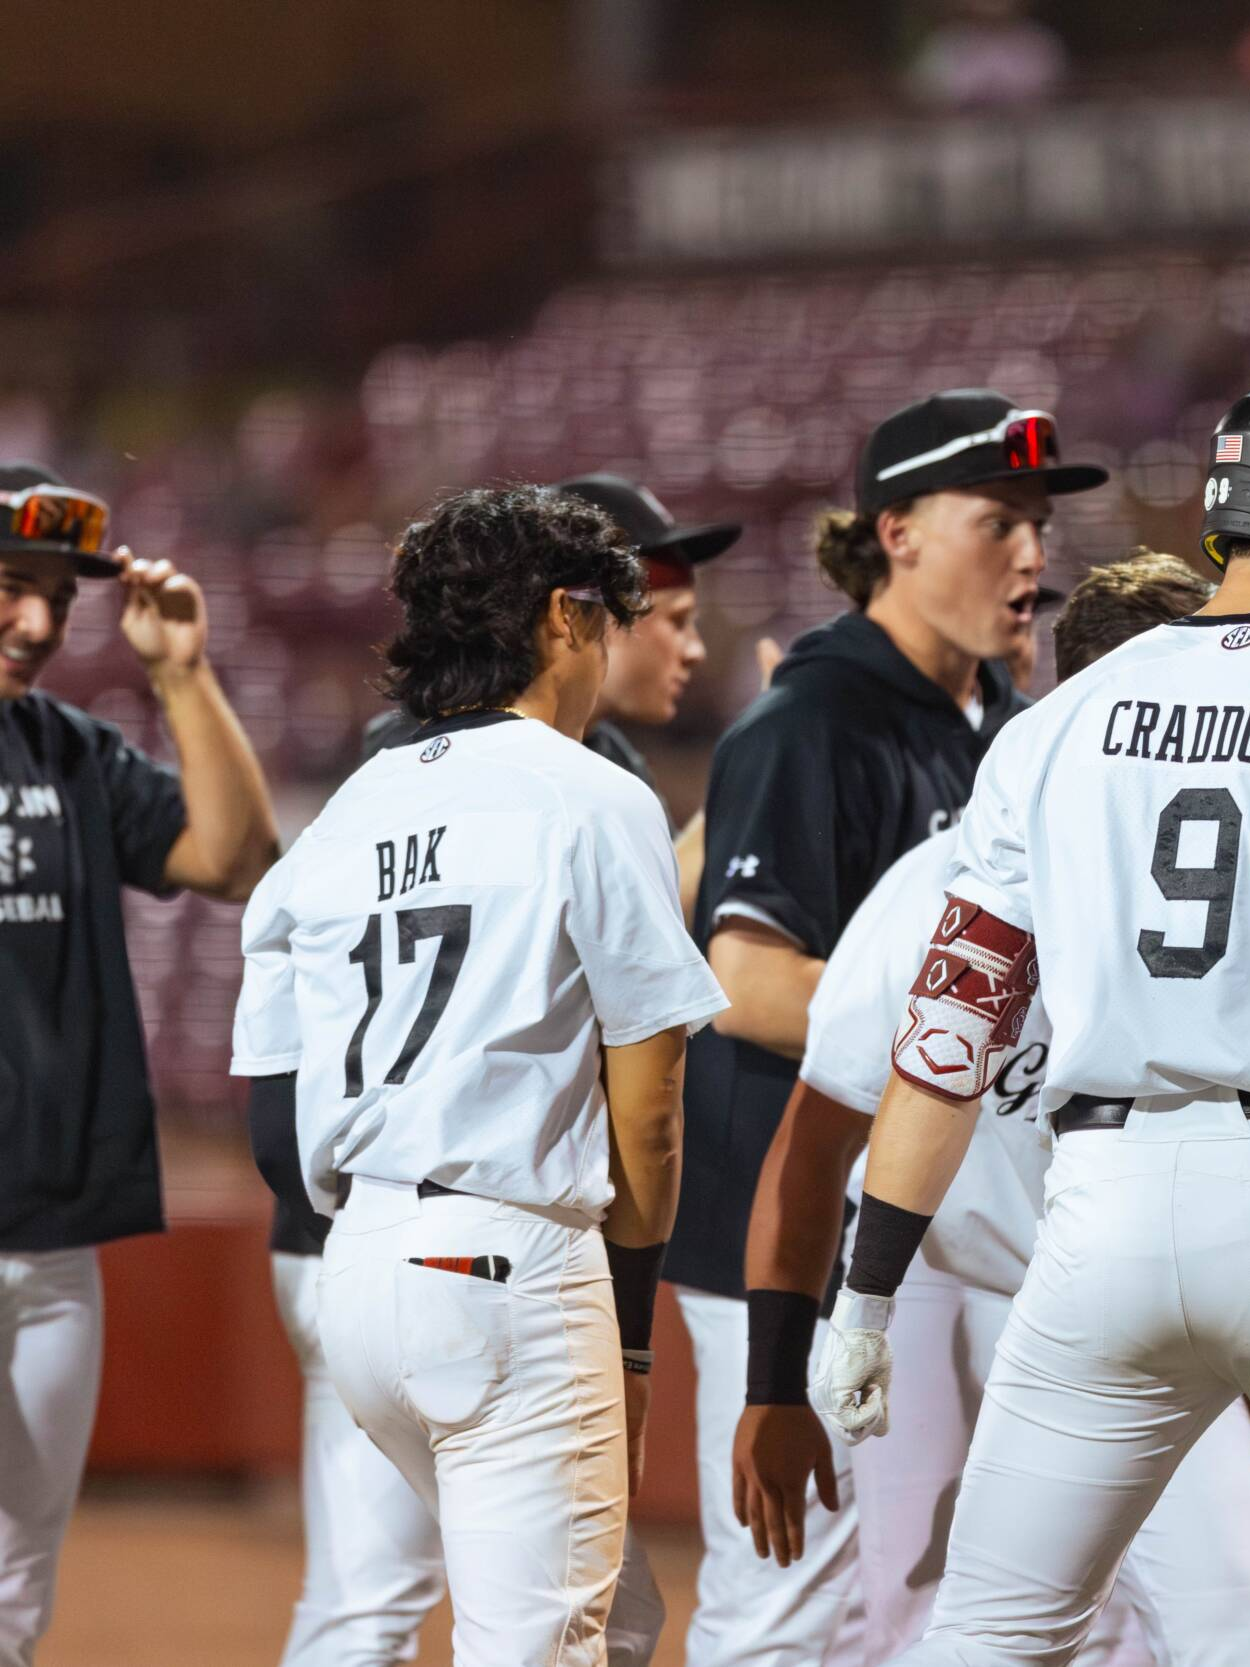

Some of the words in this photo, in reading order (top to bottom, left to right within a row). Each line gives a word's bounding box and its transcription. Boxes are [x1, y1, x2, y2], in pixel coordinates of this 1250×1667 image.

[376, 825, 447, 902] BAK
[1137, 787, 1242, 980] 9
[343, 904, 472, 1098] 17
